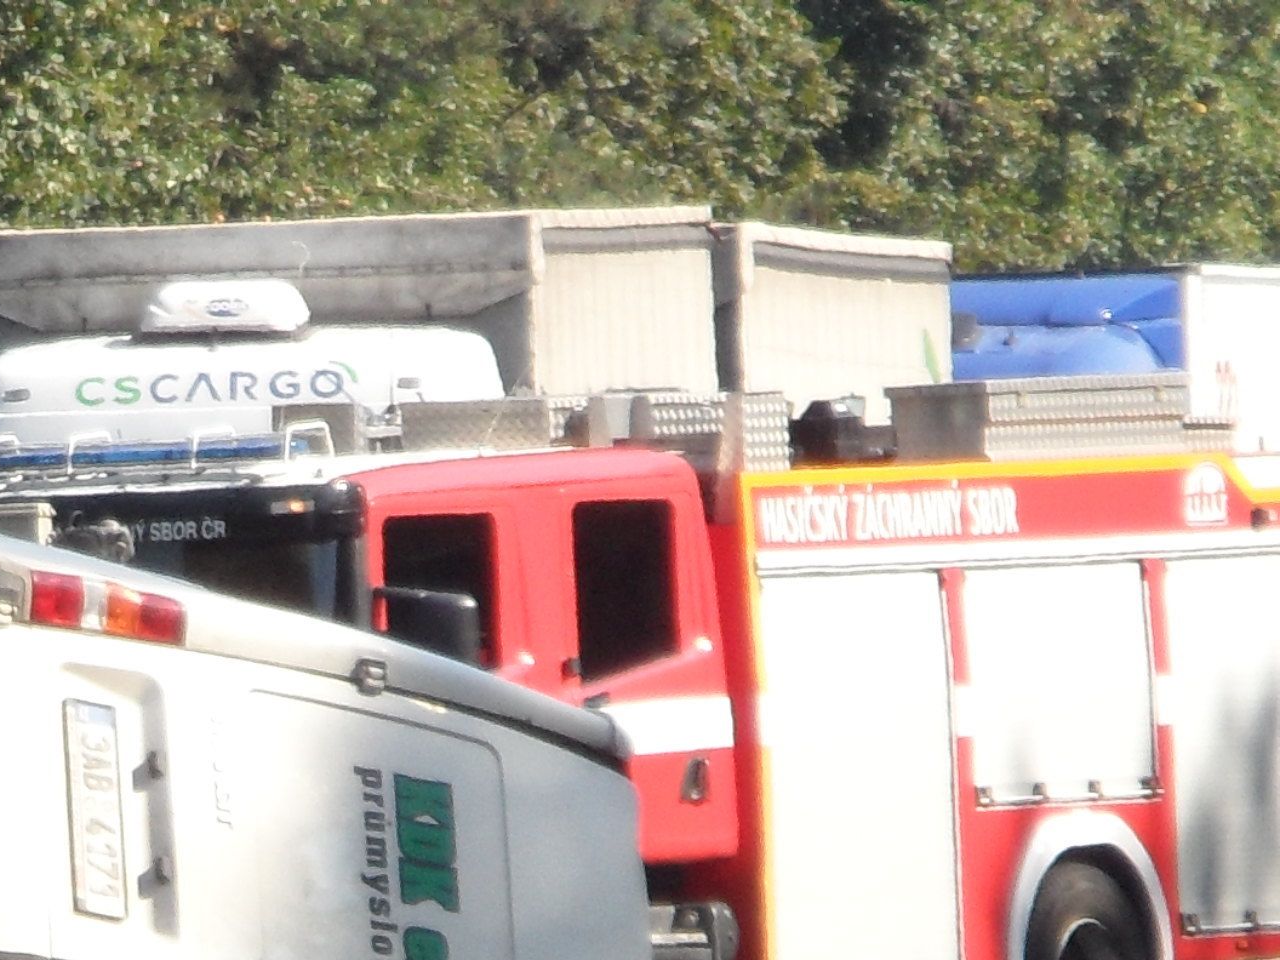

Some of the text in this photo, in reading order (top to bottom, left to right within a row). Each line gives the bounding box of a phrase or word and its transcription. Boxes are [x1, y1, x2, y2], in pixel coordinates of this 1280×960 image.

[75, 369, 344, 406] CSCARGO
[150, 520, 198, 542] SBOR
[201, 516, 226, 539] ČR
[965, 486, 1019, 536] SBOR
[393, 773, 461, 914] KDK
